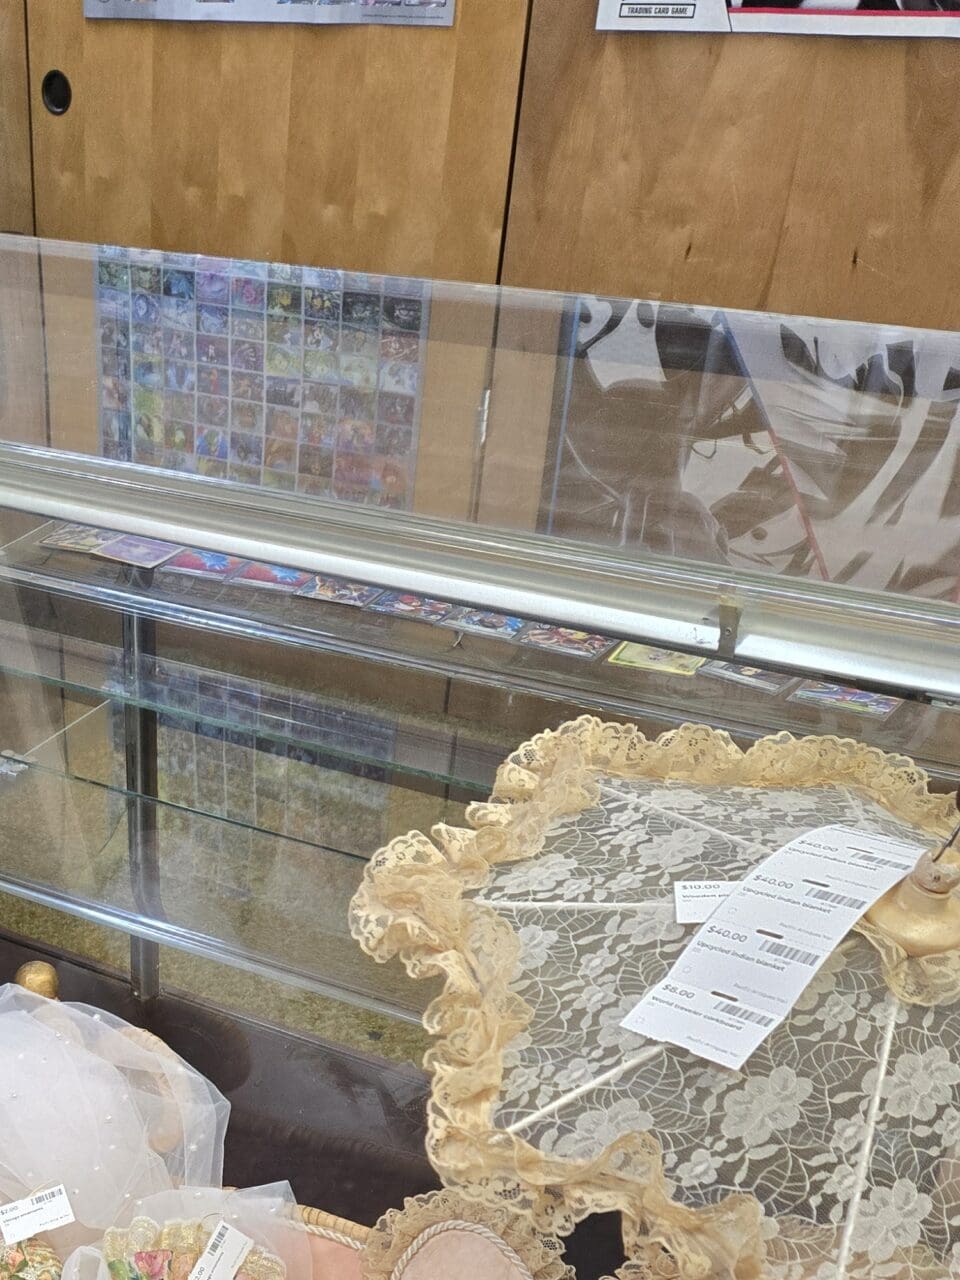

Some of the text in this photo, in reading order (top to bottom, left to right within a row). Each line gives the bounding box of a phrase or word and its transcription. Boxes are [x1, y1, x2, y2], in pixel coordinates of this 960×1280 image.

[752, 874, 794, 889] $40.00
[707, 925, 748, 943] $40.00
[696, 940, 731, 956] Upcycled
[755, 957, 786, 973] blanket
